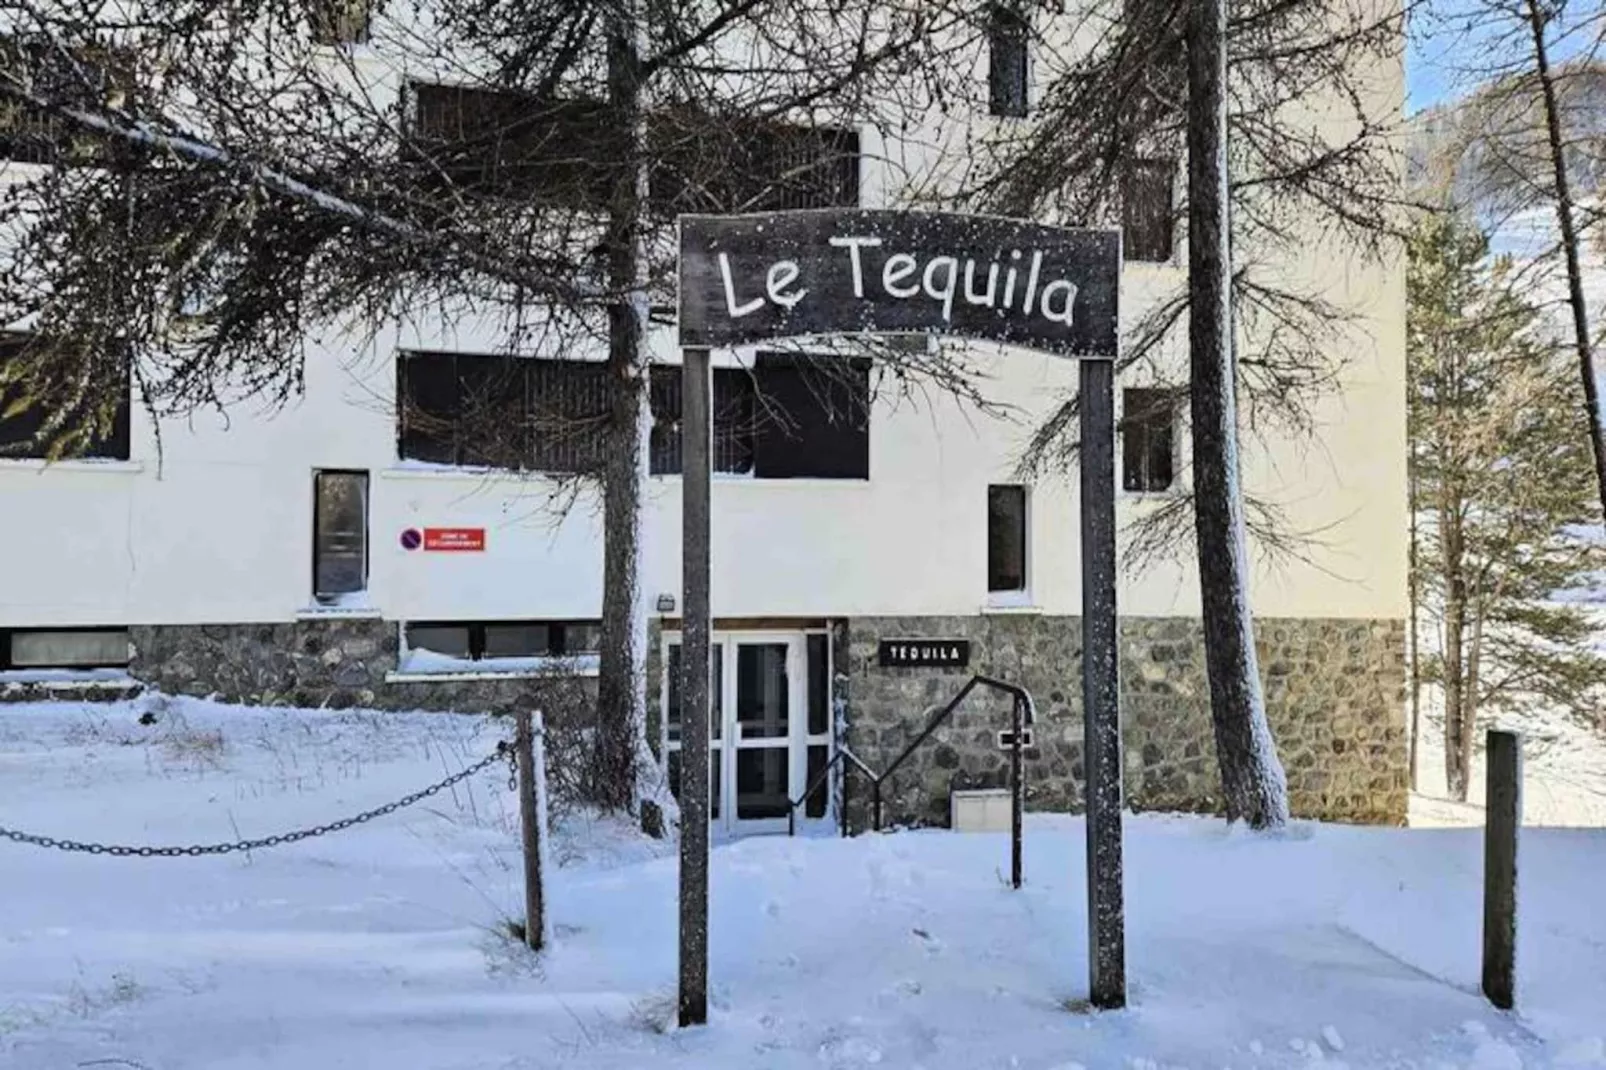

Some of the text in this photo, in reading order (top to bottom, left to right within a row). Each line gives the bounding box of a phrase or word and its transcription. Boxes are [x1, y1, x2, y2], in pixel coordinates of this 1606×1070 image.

[719, 237, 1079, 327] Le Tequila
[889, 645, 960, 660] TEQUILA
